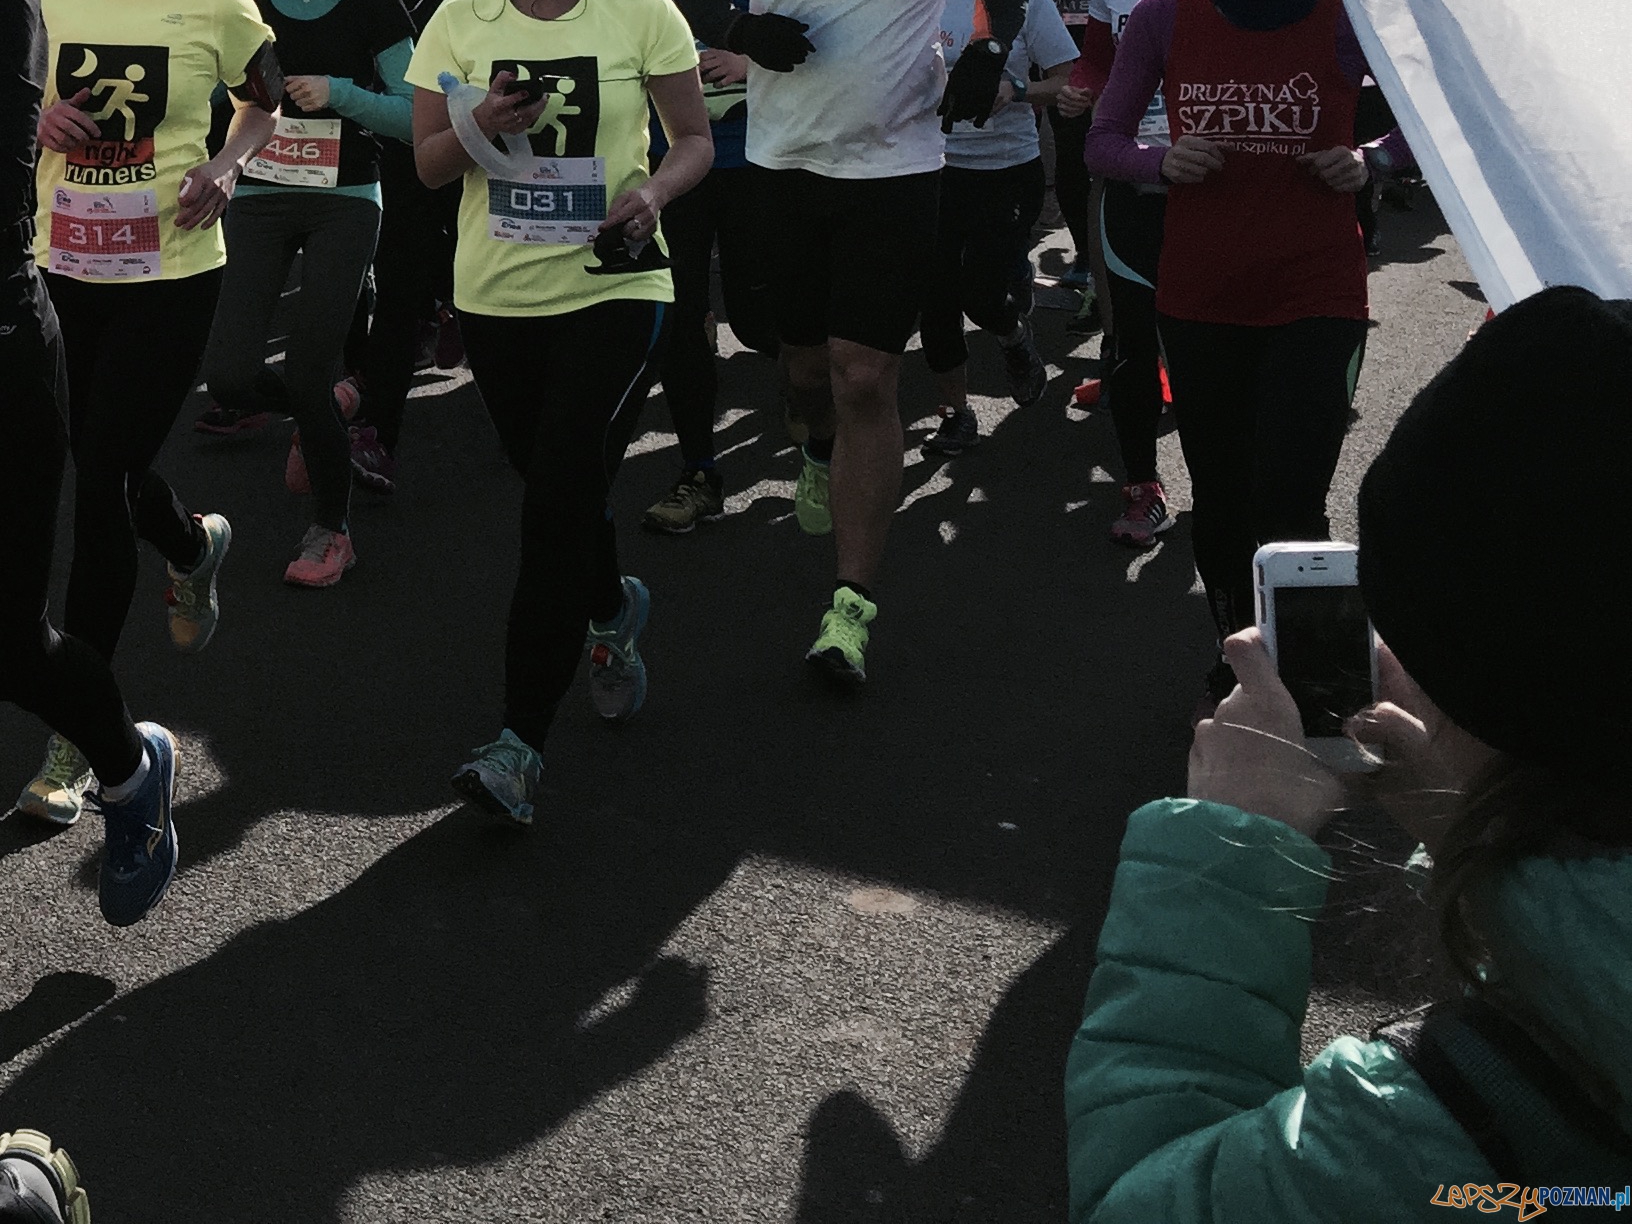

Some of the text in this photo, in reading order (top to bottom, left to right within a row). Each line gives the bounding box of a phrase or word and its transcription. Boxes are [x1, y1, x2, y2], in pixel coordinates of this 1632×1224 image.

[1179, 80, 1294, 103] DRUŻYNA
[1179, 103, 1321, 134] SZPIKU
[265, 139, 320, 159] 446
[66, 163, 156, 184] runners
[511, 188, 573, 212] 031
[69, 223, 136, 246] 314
